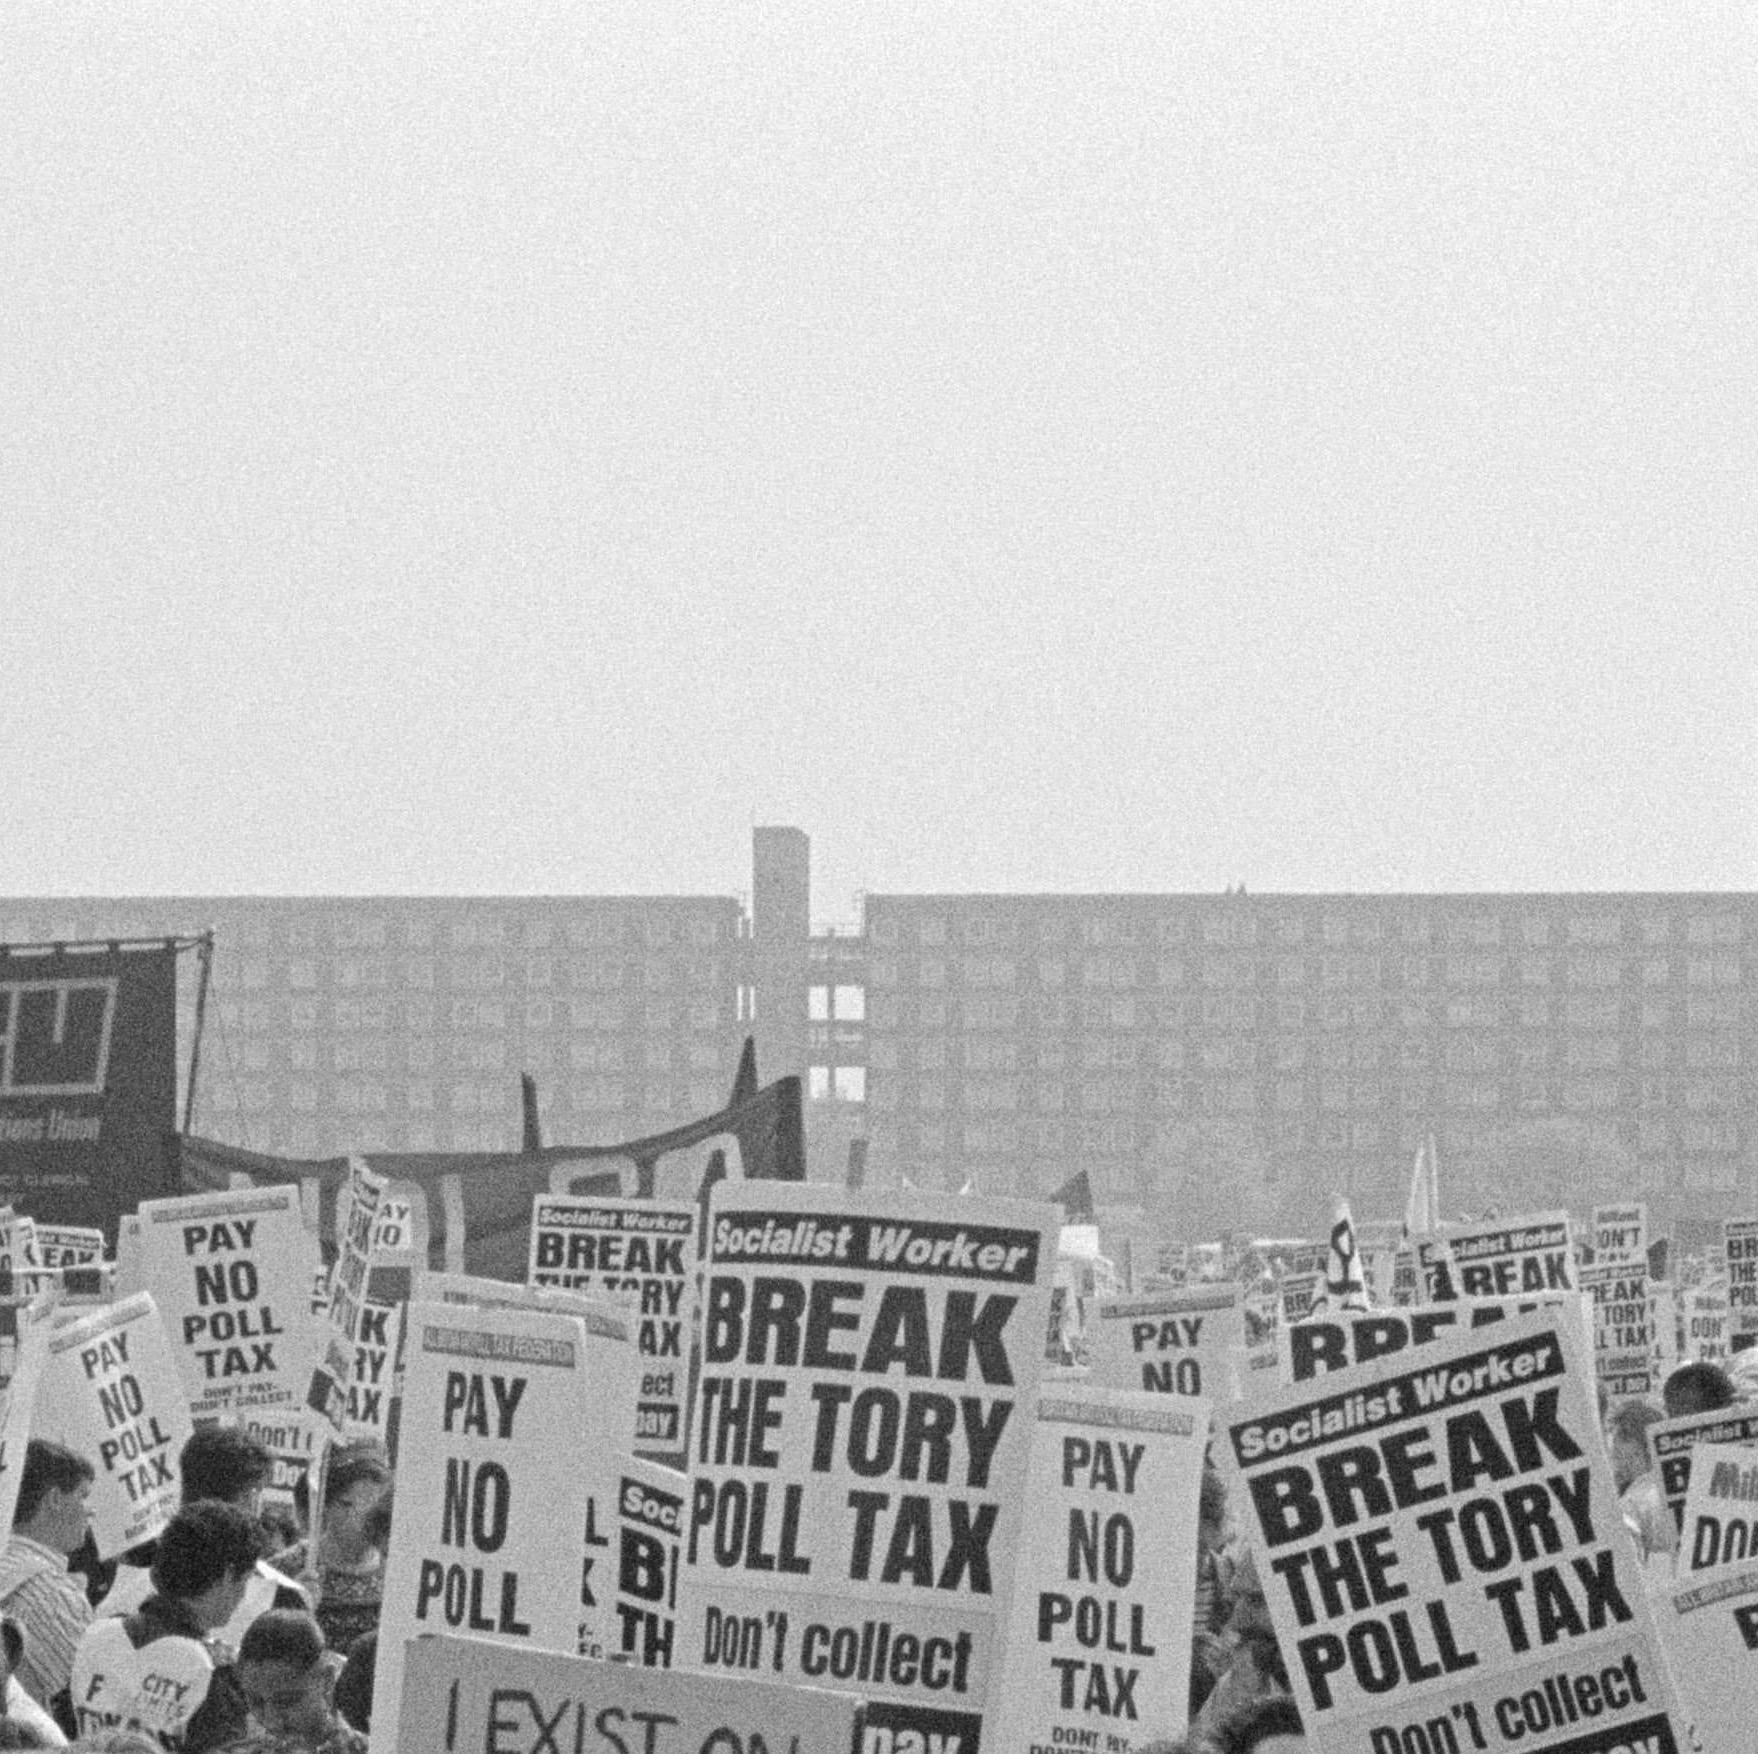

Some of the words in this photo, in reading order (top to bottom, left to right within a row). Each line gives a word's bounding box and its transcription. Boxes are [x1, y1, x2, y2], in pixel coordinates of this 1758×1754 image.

[183, 1220, 257, 1256] PAY
[540, 1207, 615, 1230] Socialist
[620, 1212, 690, 1234] Worker
[713, 1218, 849, 1262] Socialist
[866, 1226, 1028, 1274] Worker
[195, 1260, 259, 1306] NO
[539, 1233, 687, 1276] BREAK
[79, 1332, 131, 1381] PAY
[183, 1306, 284, 1345] POLL
[705, 1273, 1019, 1387] BREAK
[1132, 1317, 1203, 1352] PAY
[196, 1342, 278, 1379] TAX
[1141, 1357, 1203, 1396] NO
[98, 1373, 145, 1429] NO
[443, 1369, 528, 1440] PAY
[698, 1373, 791, 1469] THE
[810, 1382, 1015, 1489] TORY
[1241, 1384, 1402, 1461] Socialist
[1413, 1345, 1552, 1412] Worker
[99, 1415, 173, 1472] POLL
[1060, 1435, 1146, 1495] PAY
[1247, 1385, 1586, 1548] BREAK
[118, 1453, 176, 1503] TAX
[442, 1456, 511, 1554] NO
[688, 1478, 812, 1575] POLL
[846, 1489, 999, 1596] TAX
[1066, 1507, 1136, 1589] NO
[1270, 1529, 1412, 1629] THE
[1417, 1465, 1596, 1586] TORY
[415, 1556, 532, 1637] POLL
[1037, 1592, 1156, 1657] POLL
[704, 1605, 789, 1673] Don't
[799, 1619, 973, 1694] collect
[1294, 1604, 1480, 1712] POLL
[1485, 1548, 1636, 1655] TAX
[142, 1671, 191, 1702] CITY
[442, 1679, 460, 1752] I
[1050, 1656, 1141, 1721] TAX
[1498, 1654, 1649, 1742] collect
